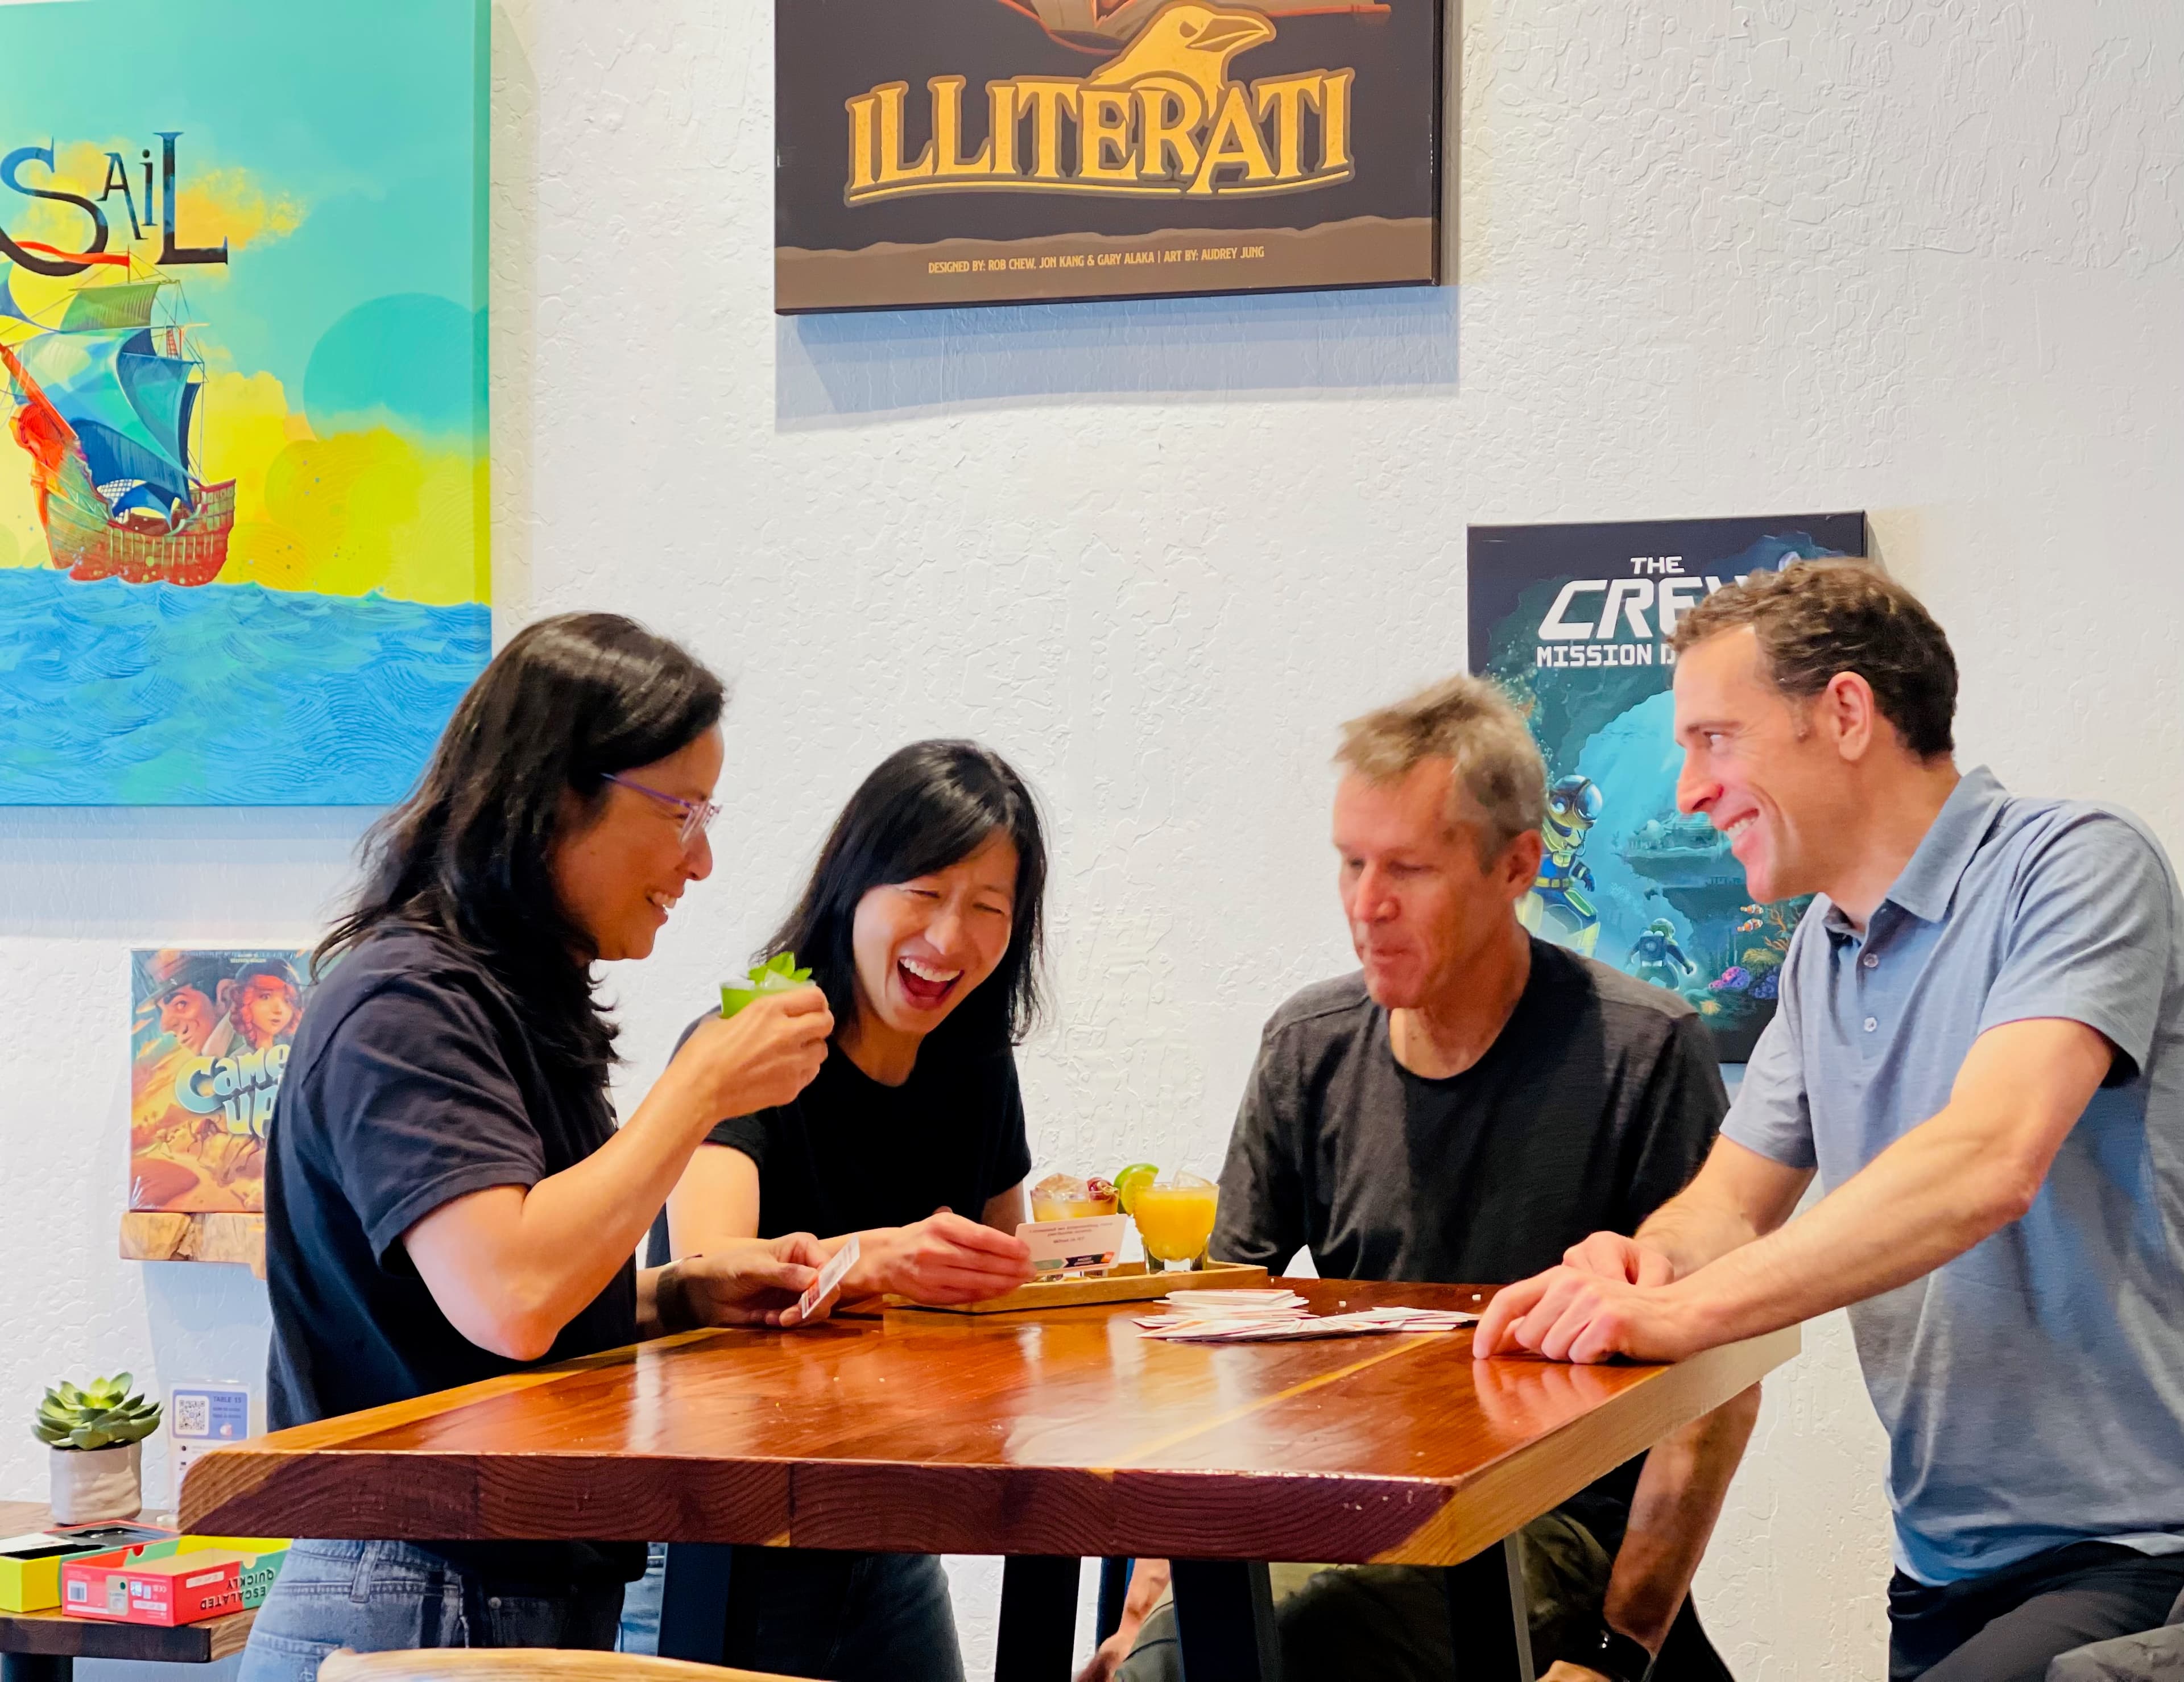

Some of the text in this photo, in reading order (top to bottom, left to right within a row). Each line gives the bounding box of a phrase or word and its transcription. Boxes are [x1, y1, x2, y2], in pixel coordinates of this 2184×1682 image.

[849, 73, 1351, 194] ILLITERATI
[928, 261, 970, 274] DESIGNED
[972, 259, 986, 271] BY:
[988, 259, 1006, 271] ROB
[1039, 256, 1057, 268] JON
[1059, 255, 1084, 267] KANG
[1087, 254, 1095, 266] &
[1097, 253, 1122, 266] GARY
[1124, 251, 1155, 265] ALAKA
[1164, 250, 1182, 262] ART
[1185, 249, 1198, 261] BY:
[1201, 247, 1238, 261] AUDREY
[1240, 246, 1265, 258] JUNG
[1630, 556, 1685, 575] THE
[1538, 575, 1748, 640] CRE
[1537, 643, 1653, 667] MISSION
[227, 1568, 274, 1590] QUICKLY
[200, 1586, 266, 1610] ESCALATED
